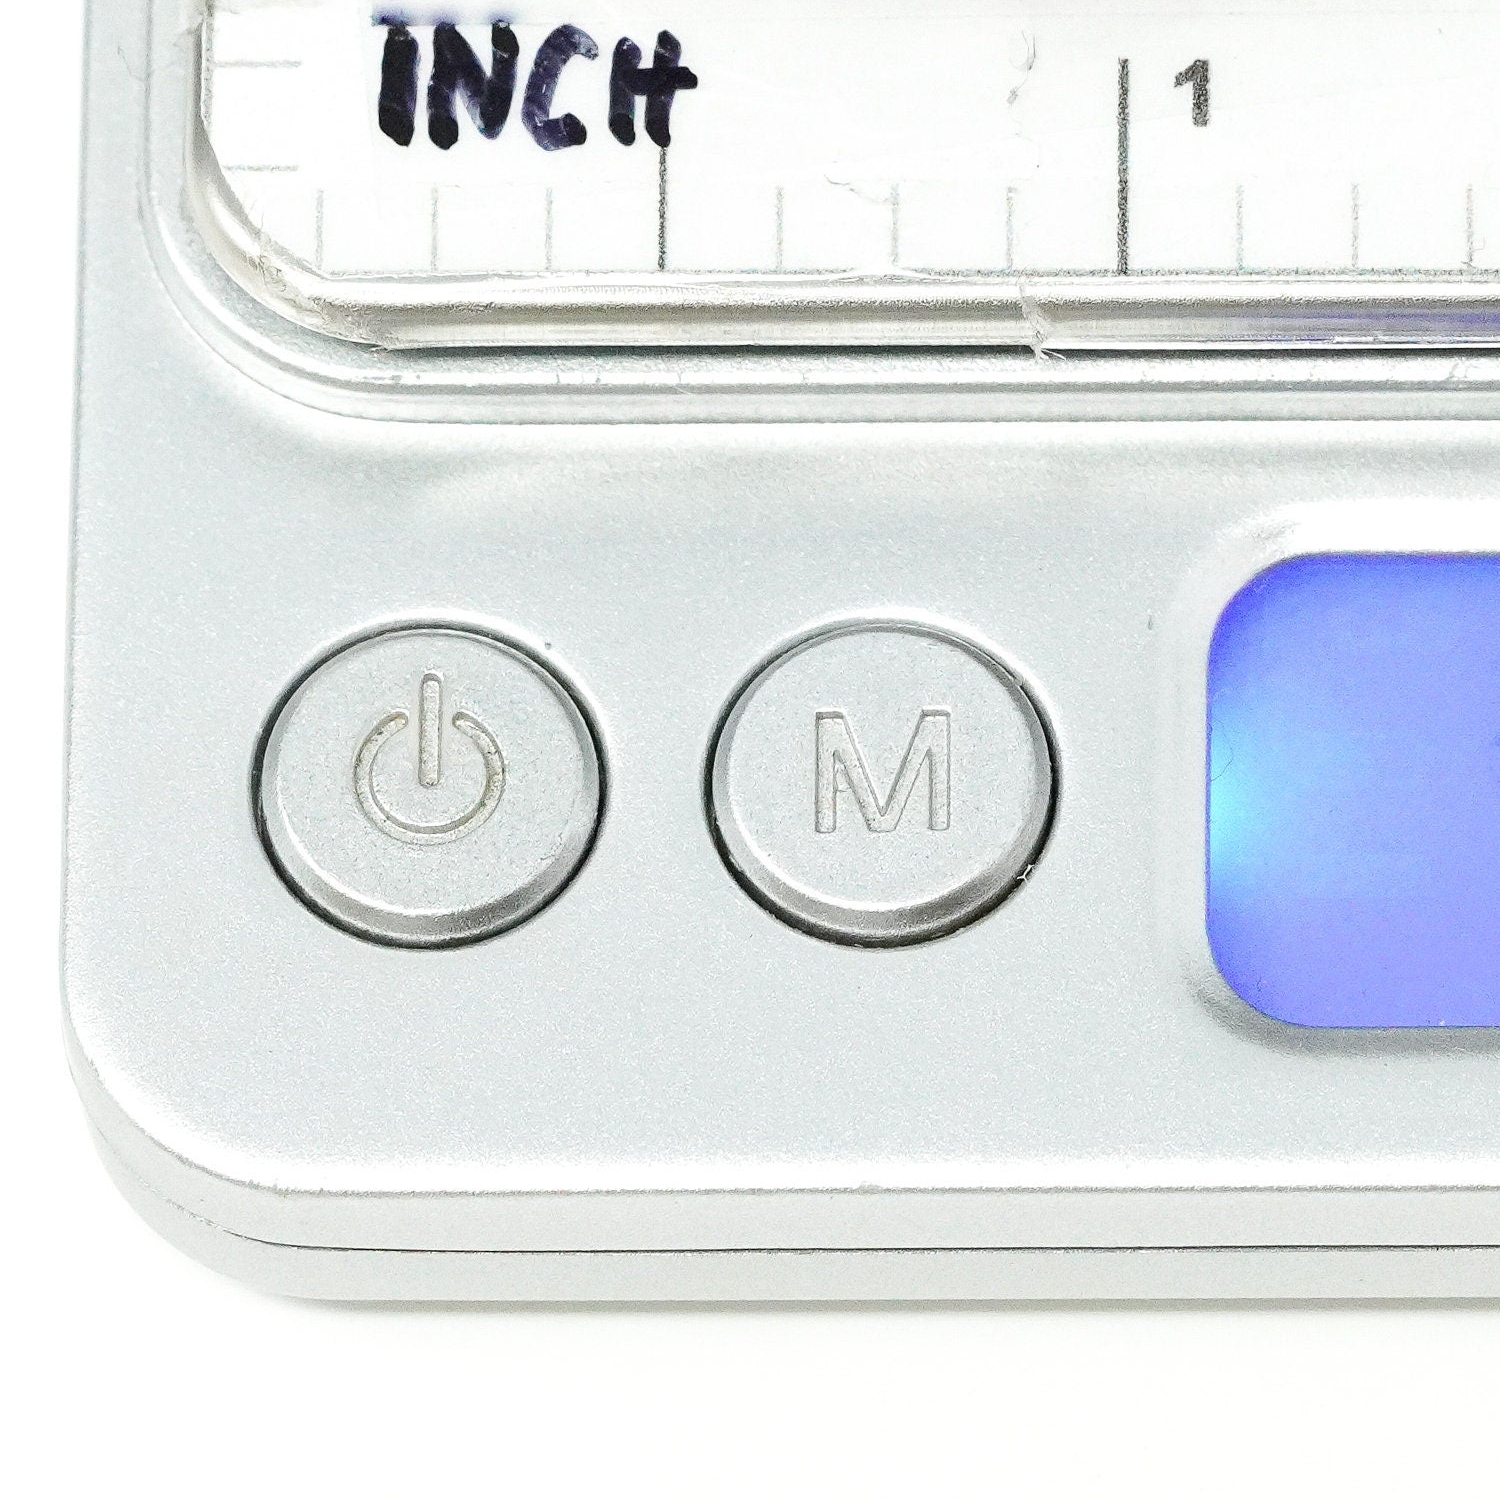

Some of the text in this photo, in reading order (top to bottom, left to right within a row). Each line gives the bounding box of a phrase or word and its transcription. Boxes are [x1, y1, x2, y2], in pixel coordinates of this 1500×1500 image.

[374, 16, 699, 151] INCH
[1173, 58, 1211, 127] 1
[813, 708, 952, 834] M
